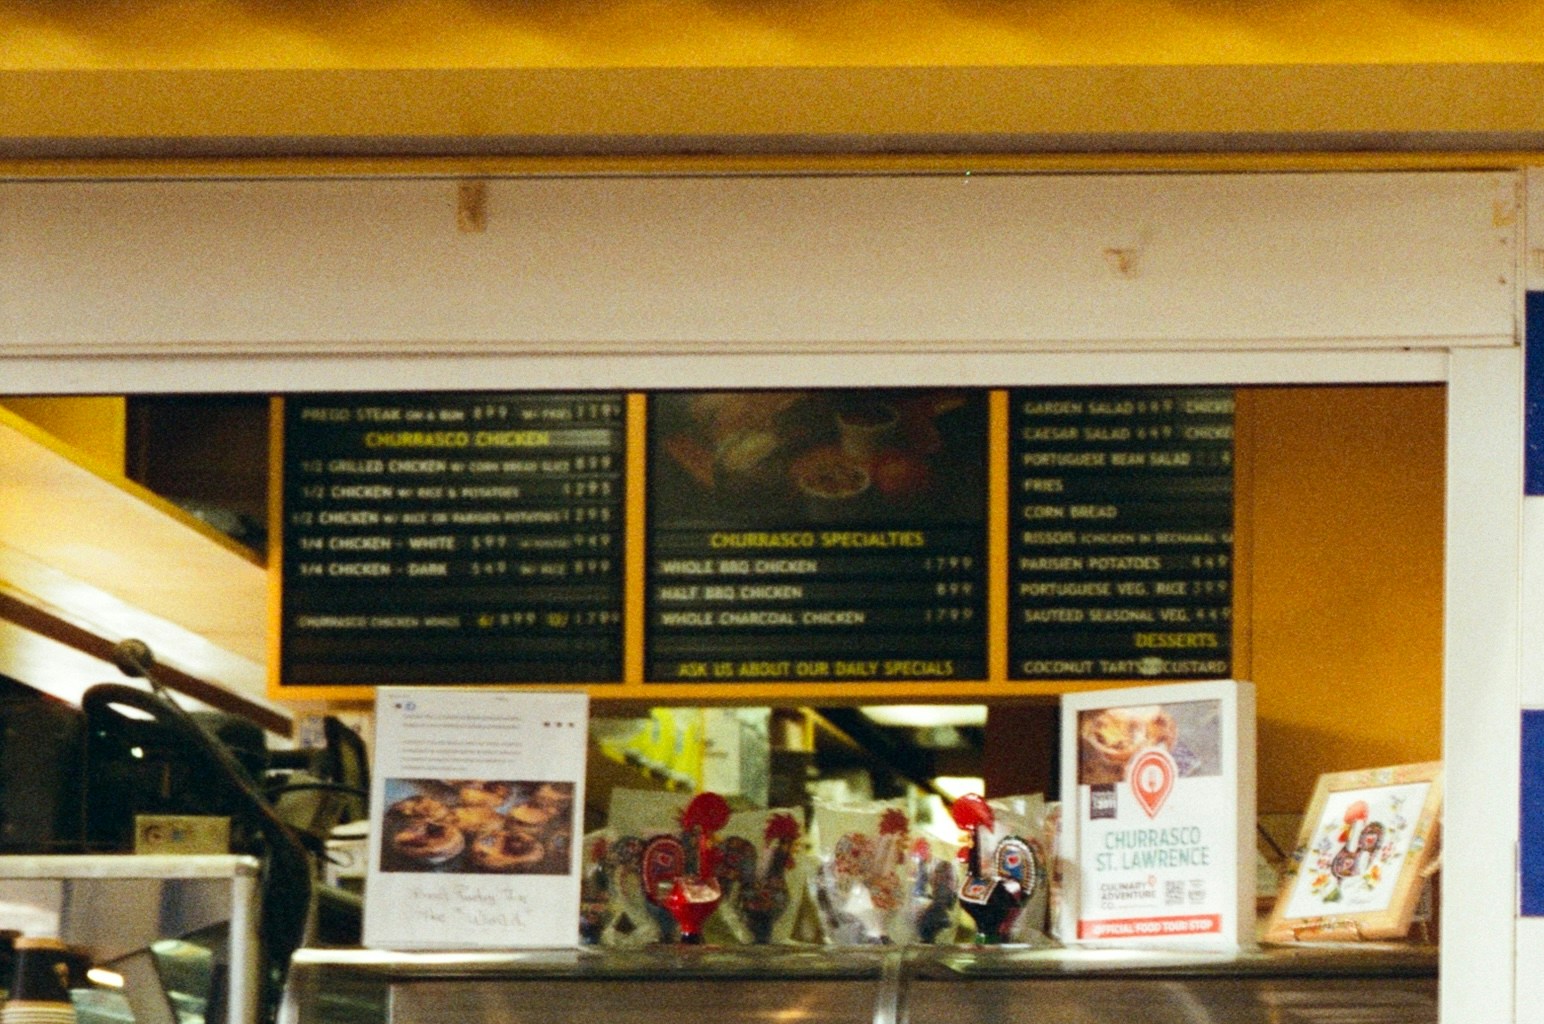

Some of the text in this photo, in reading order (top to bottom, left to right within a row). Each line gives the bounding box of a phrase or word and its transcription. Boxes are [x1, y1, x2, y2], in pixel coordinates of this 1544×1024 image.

[357, 408, 401, 421] STEAK
[1087, 401, 1135, 415] SALAD
[365, 430, 550, 448] CHURRASCO CHICKEN
[1083, 427, 1131, 441] SALAD
[328, 460, 384, 474] GRILLED
[389, 459, 446, 473] CHICKEN
[1111, 453, 1145, 466] BEAN
[1150, 453, 1191, 466] SALAD
[331, 485, 393, 499] CHICKEN
[319, 511, 379, 525] CHICKEN
[1023, 504, 1117, 519] CORN BREAD
[300, 537, 323, 551] 1/4
[328, 537, 391, 551] CHICKEN
[409, 536, 455, 550] WHITE
[709, 530, 925, 549] CHURRASCO SPECIALTIES
[300, 563, 323, 577] 1/4
[328, 563, 391, 577] CHICKEN
[407, 563, 447, 577] DARK
[659, 559, 713, 575] WHOLE
[719, 558, 749, 574] BBQ
[755, 558, 817, 574] CHICKEN
[1021, 557, 1083, 570] PARISIEN
[1086, 556, 1161, 570] POTATOES
[660, 585, 695, 601] HALF
[705, 584, 735, 600] BBQ
[740, 584, 802, 600] CHICKEN
[1020, 582, 1111, 596] PORTUGUESE
[1156, 582, 1187, 596] RICE
[659, 611, 713, 626] WHOLE
[719, 611, 797, 626] CHARCOAL
[802, 610, 865, 625] CHICKEN
[1023, 608, 1084, 622] SAUTEED
[1089, 608, 1154, 622] SEASONAL
[1135, 632, 1218, 648] DESSERTS
[677, 659, 954, 678] ASK US ABOUT OUR DAILY SPECIALS
[1023, 659, 1092, 674] COCONUT
[1160, 659, 1227, 674] CUSTARD
[1104, 826, 1200, 850] CHURRASCO
[1096, 847, 1210, 872] ST. LAWRENCE
[1101, 881, 1147, 892] CULINARY
[1101, 889, 1157, 900] ADVENTURE
[1093, 919, 1213, 936] OFFICIAL FOOD TOUR STOP
